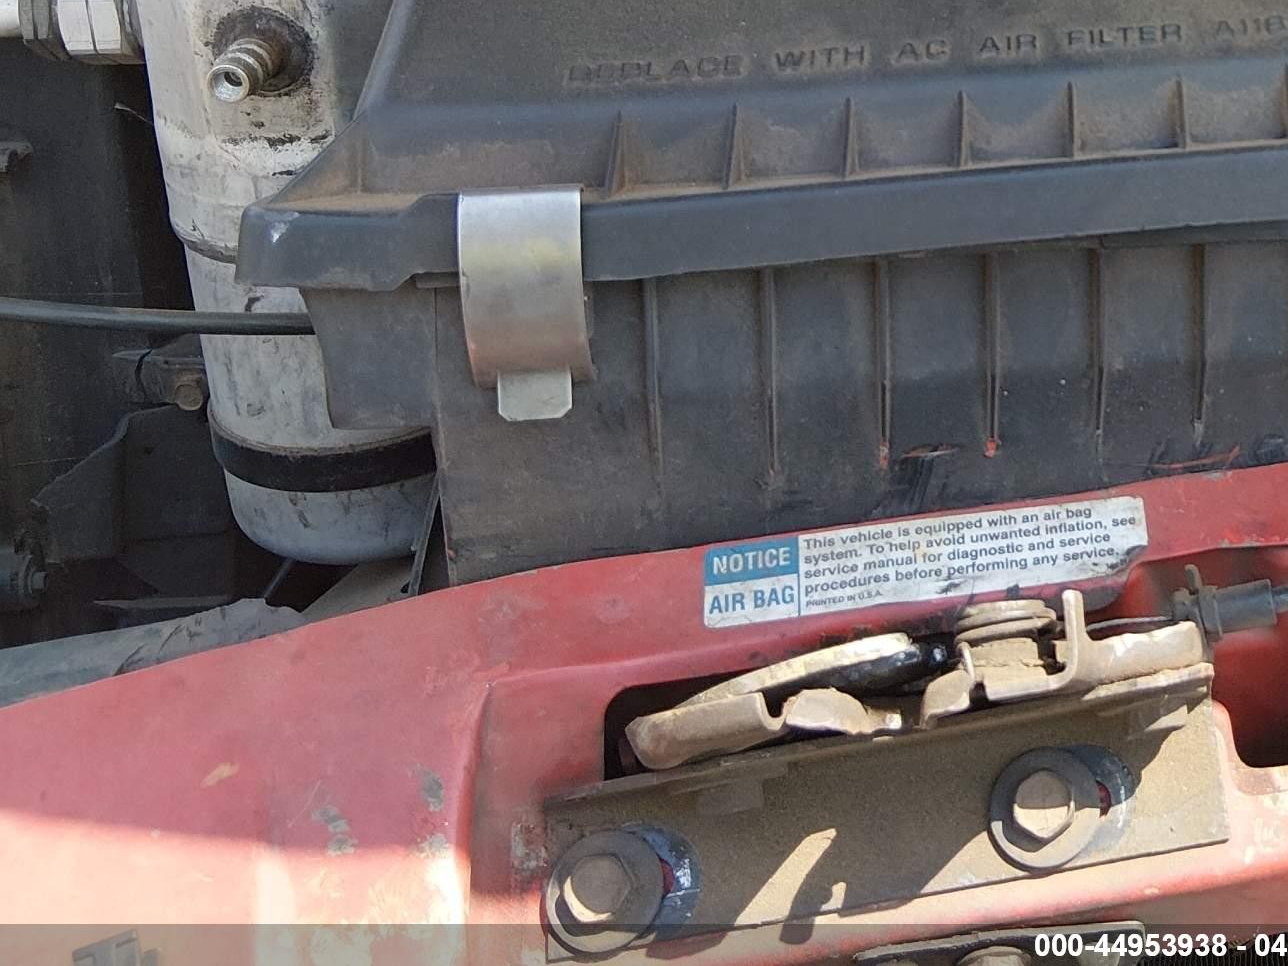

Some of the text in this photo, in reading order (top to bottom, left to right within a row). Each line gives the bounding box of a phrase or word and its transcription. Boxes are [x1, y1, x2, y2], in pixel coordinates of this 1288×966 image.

[775, 44, 867, 72] WITH
[897, 38, 948, 61] AC
[979, 34, 1038, 53] AIR
[1067, 22, 1183, 47] FILTER
[804, 507, 1092, 550] This vehicle is equipped with an air bag
[804, 516, 1137, 567] system. To help avoid unwanted inflation, see
[712, 547, 792, 575] NOTICE
[804, 532, 1111, 580] service manual for diagnostic and service
[804, 546, 1120, 597] procedures before performing any service.
[708, 585, 795, 614] AIR BAG
[805, 596, 845, 608] PRINTED
[847, 594, 857, 602] IN
